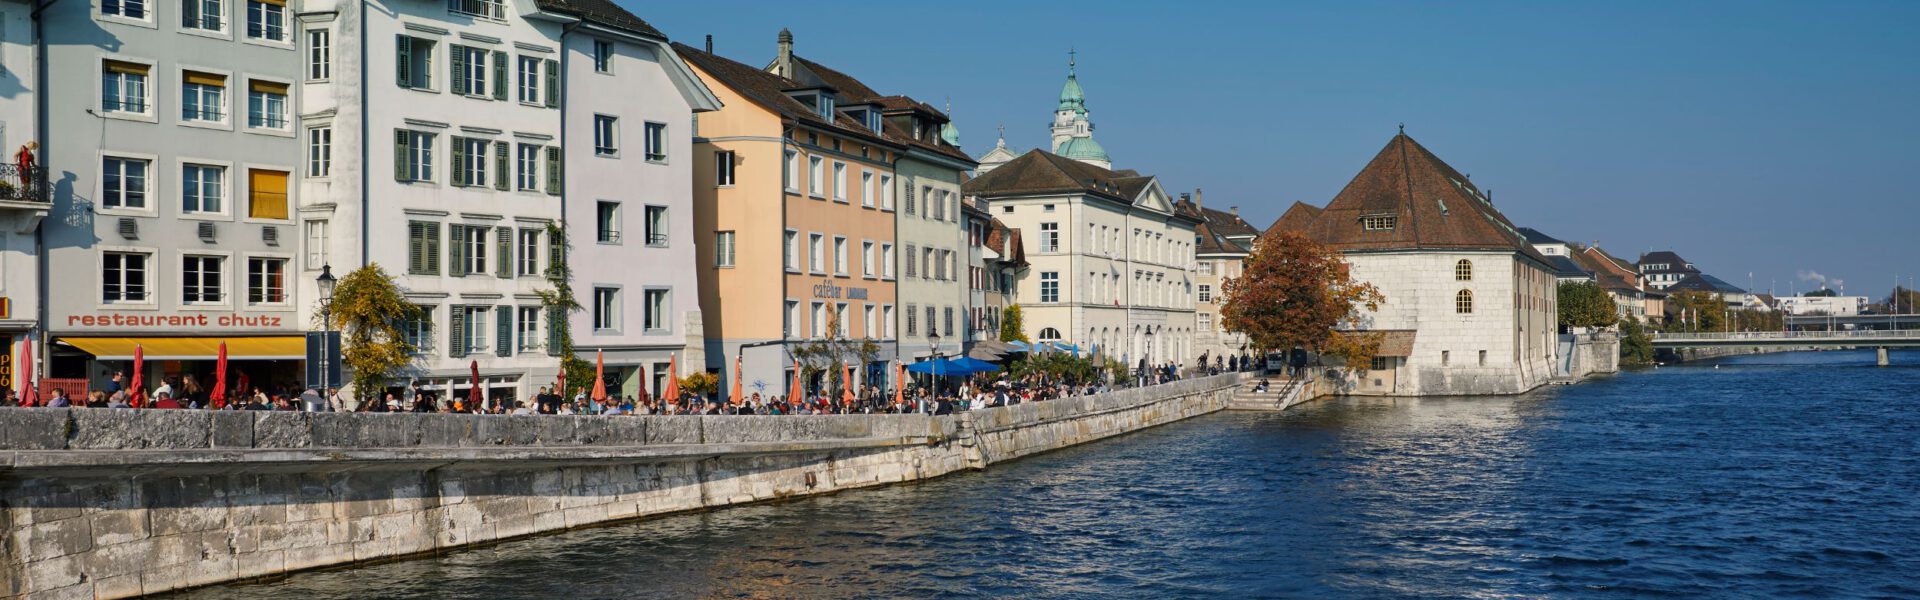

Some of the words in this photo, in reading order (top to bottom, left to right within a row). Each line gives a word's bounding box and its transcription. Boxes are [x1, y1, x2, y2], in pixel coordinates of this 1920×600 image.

[68, 313, 208, 326] restaurant
[218, 313, 281, 326] chutz
[0, 354, 10, 387] pub
